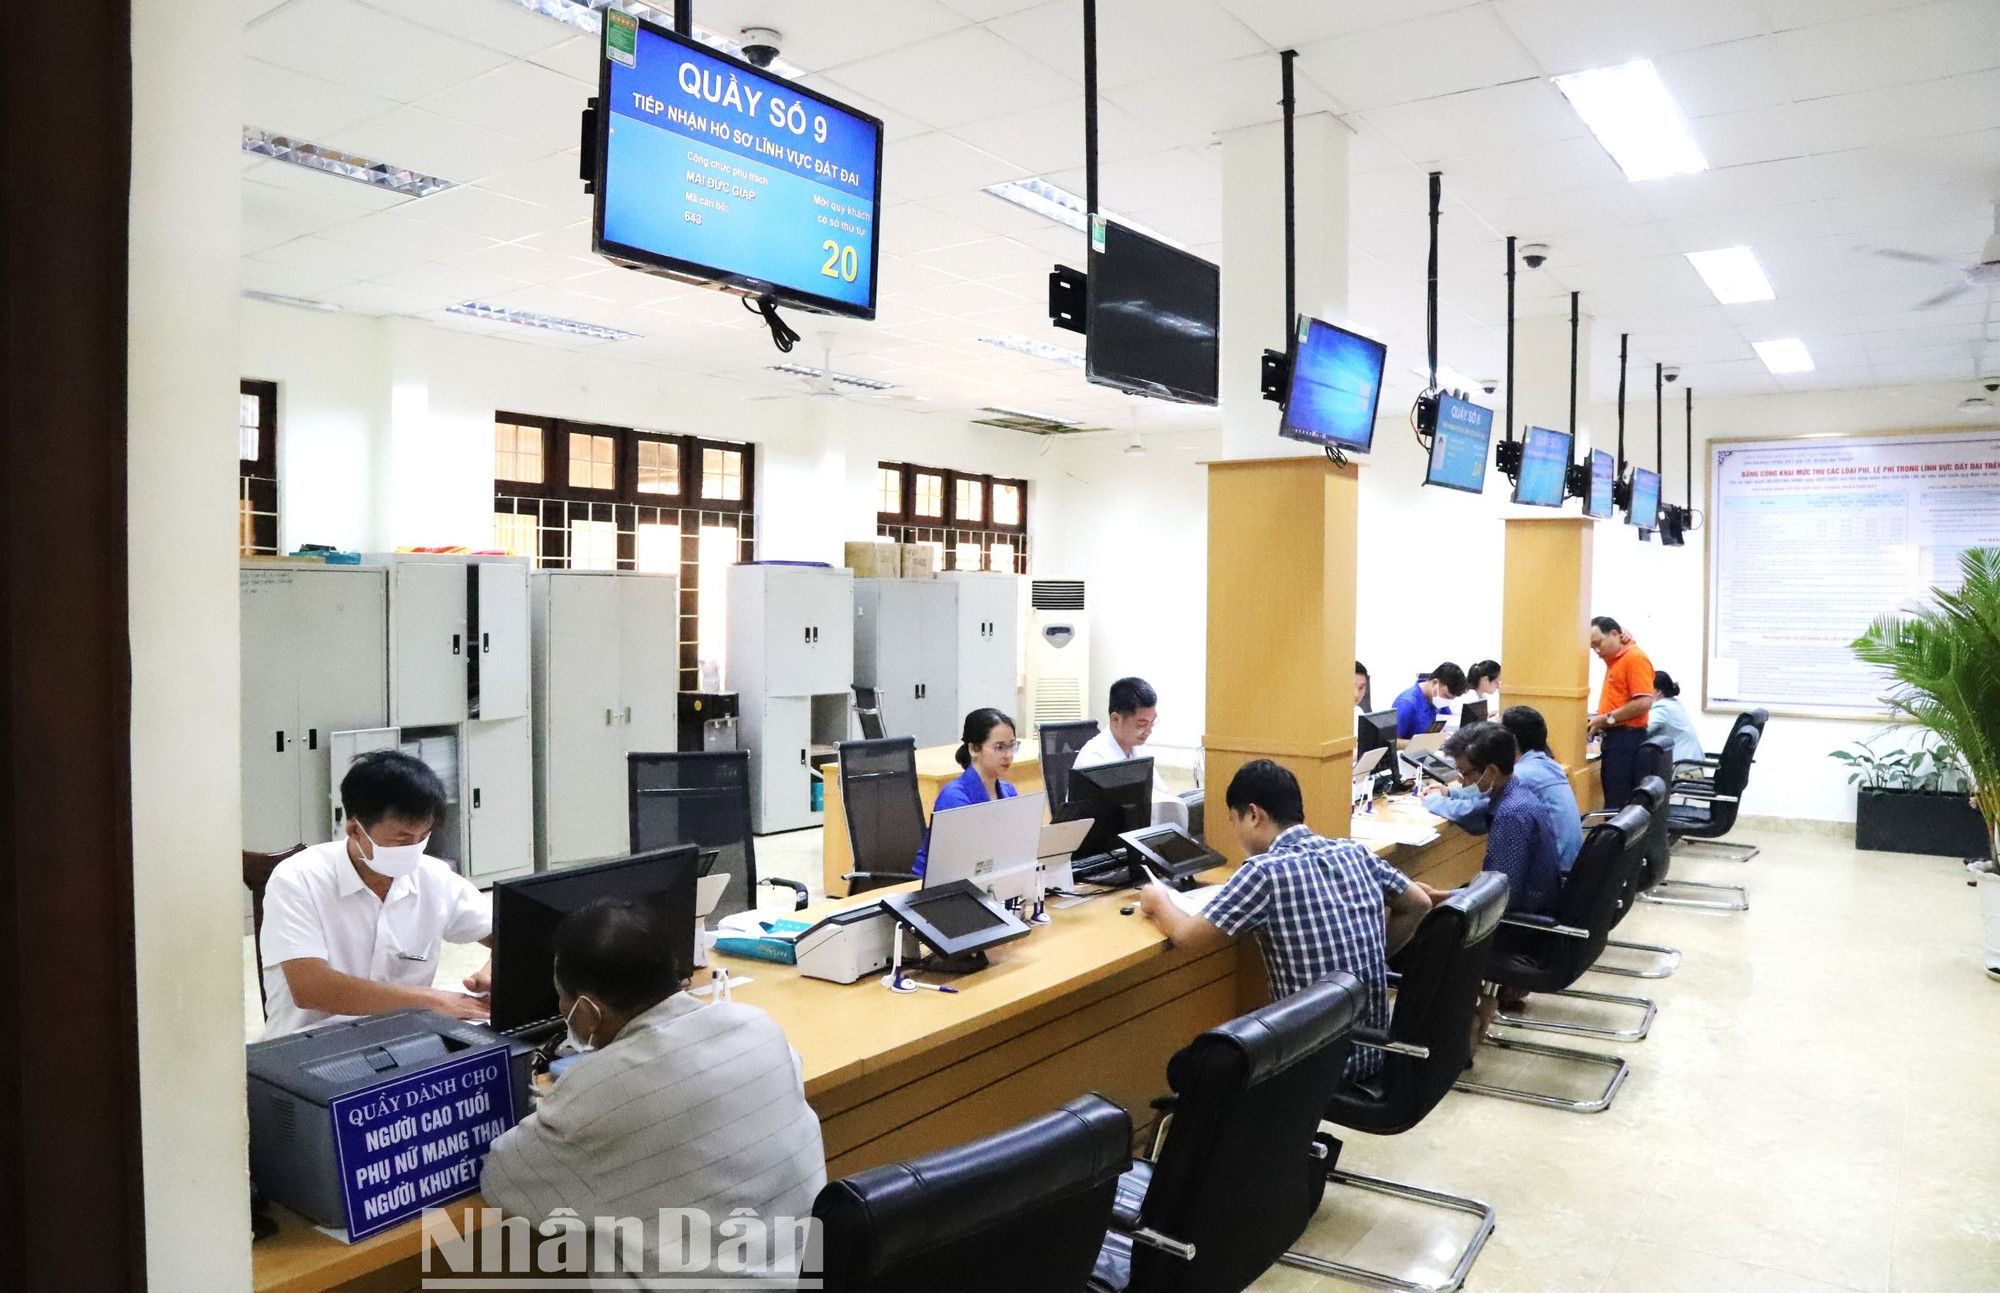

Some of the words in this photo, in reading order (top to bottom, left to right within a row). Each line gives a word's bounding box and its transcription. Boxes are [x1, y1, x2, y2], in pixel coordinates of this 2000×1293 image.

[678, 62, 763, 117] QUẦY
[769, 101, 806, 135] SỐ
[814, 115, 828, 144] 9
[632, 92, 664, 115] TIẾP
[667, 105, 706, 132] NHẬN
[710, 121, 730, 140] HỒ
[733, 129, 753, 147] SƠ
[755, 136, 784, 159] LĨNH
[786, 148, 812, 169] VỰC
[815, 158, 838, 178] ĐẤT
[840, 168, 859, 186] ĐAI
[686, 151, 709, 168] Công
[732, 167, 748, 180] phụ
[686, 170, 705, 186] MAI
[707, 175, 730, 191] ĐỨC
[732, 184, 756, 200] GIÁP
[684, 211, 702, 226] 643
[685, 191, 698, 203] Mã
[847, 206, 870, 222] khách
[821, 239, 858, 283] 20
[1779, 469, 1794, 477] KHAI
[1826, 466, 1840, 475] CÁC
[1896, 464, 1919, 472] TRONG
[1938, 463, 1953, 472] VỰC
[1970, 462, 1983, 470] ĐAI
[348, 1091, 402, 1127] QUẦY
[406, 1078, 457, 1110] DÀNH
[461, 1064, 498, 1089] CHO
[365, 1119, 417, 1153] NGƯỜI
[422, 1106, 453, 1133] CAO
[455, 1087, 491, 1121] TUỔI
[356, 1159, 391, 1190] PHỤ
[395, 1145, 419, 1175] NỮ
[422, 1133, 470, 1164] MANG
[472, 1117, 506, 1146] THAI
[364, 1186, 416, 1221] NGƯỜI
[420, 1154, 477, 1196] KHUYẾT
